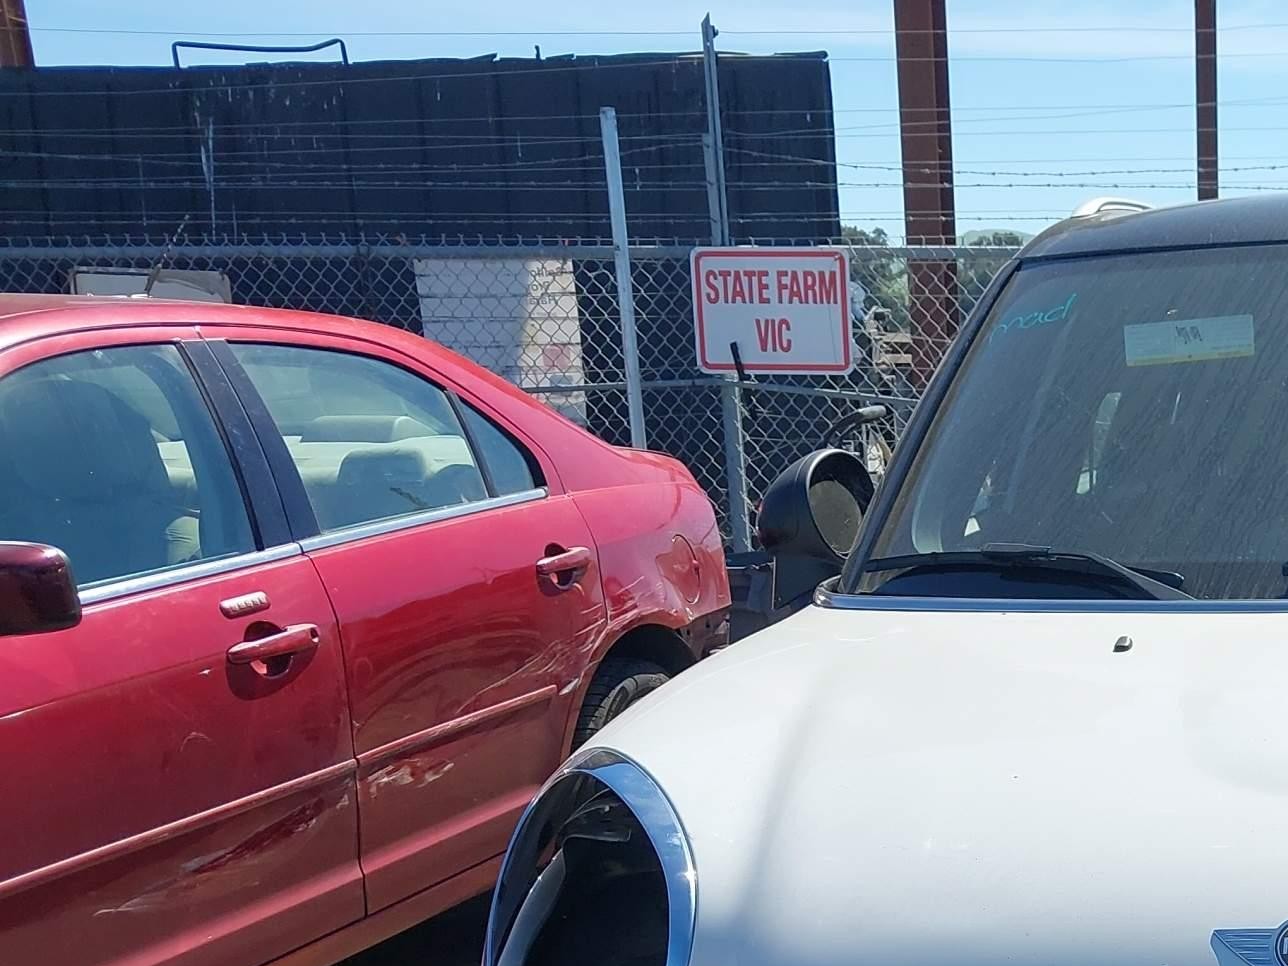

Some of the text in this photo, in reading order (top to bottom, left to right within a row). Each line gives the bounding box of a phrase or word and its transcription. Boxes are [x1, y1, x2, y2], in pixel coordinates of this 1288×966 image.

[705, 269, 838, 304] STATE FARM
[754, 318, 792, 353] VIC
